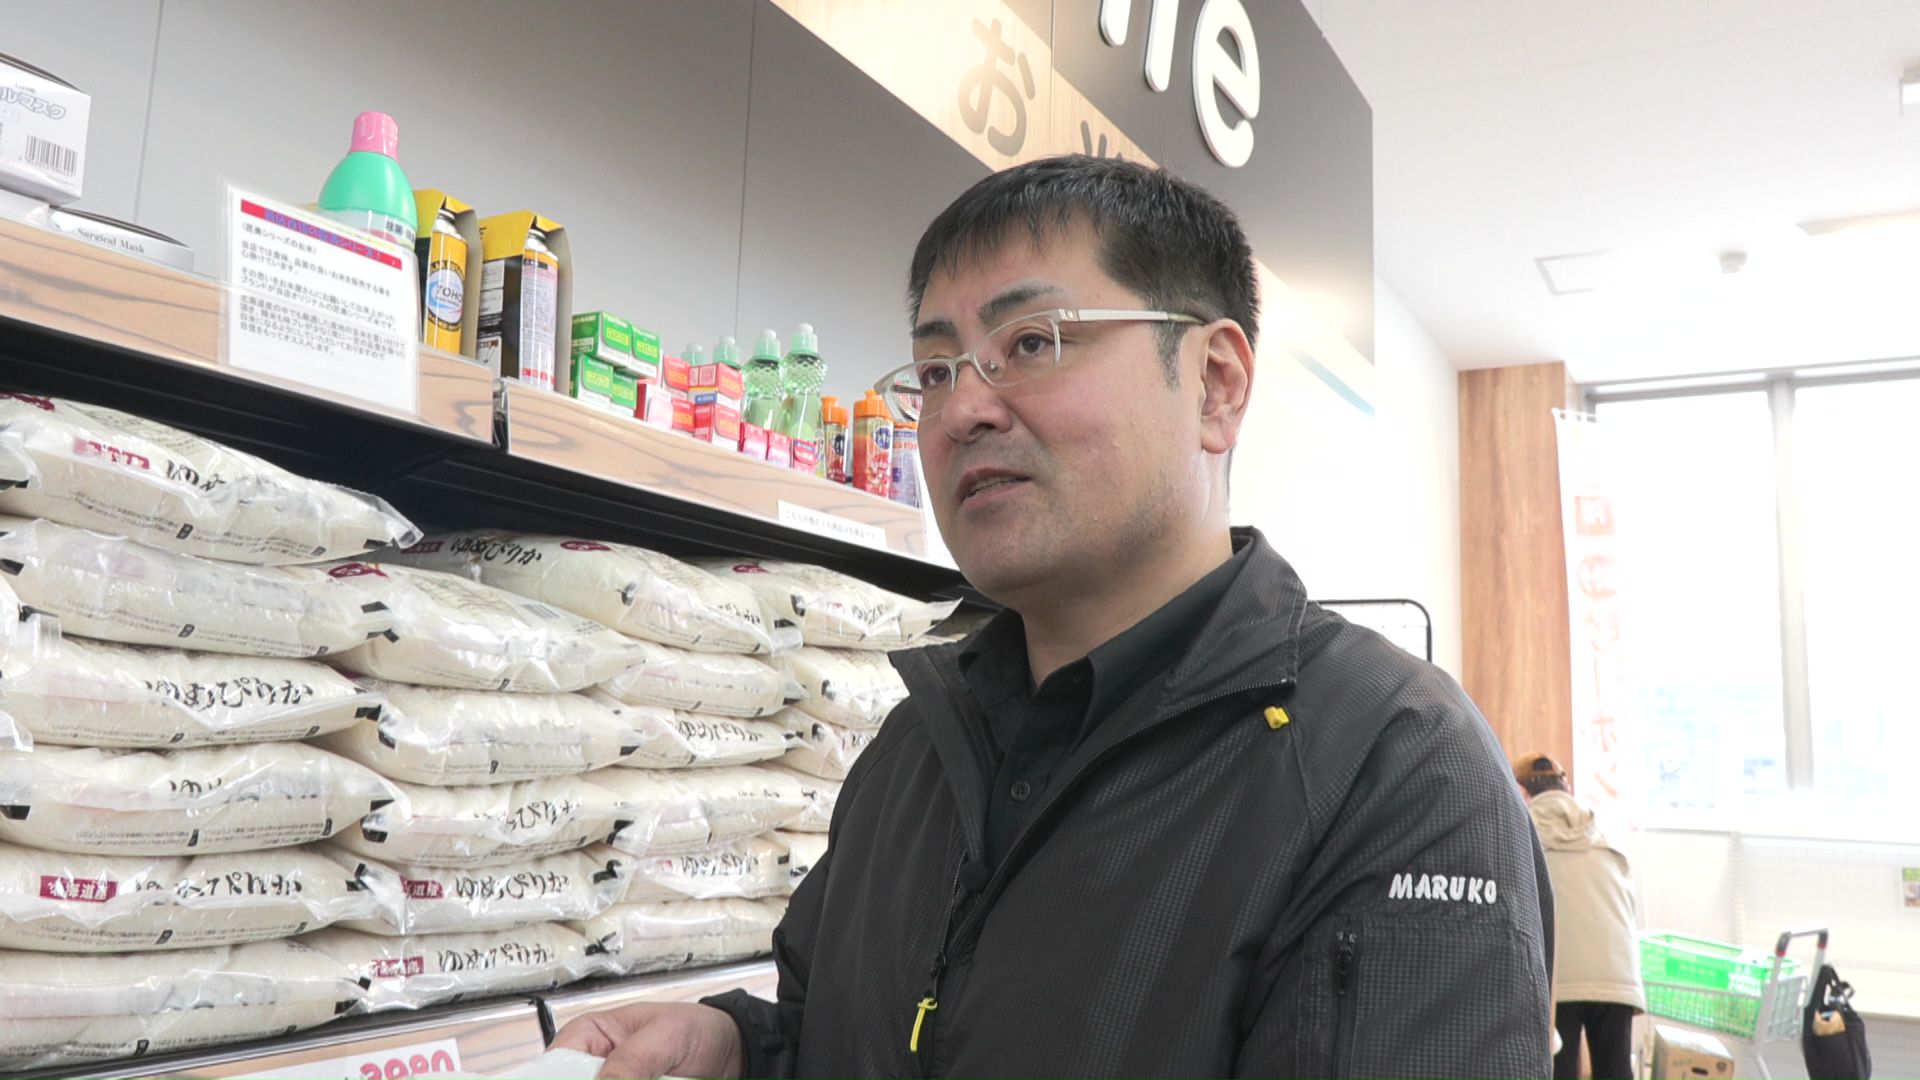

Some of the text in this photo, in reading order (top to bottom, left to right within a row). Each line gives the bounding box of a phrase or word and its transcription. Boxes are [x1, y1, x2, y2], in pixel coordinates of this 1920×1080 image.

[78, 227, 144, 254] Surgical Mask
[1388, 873, 1497, 904] MARUKO
